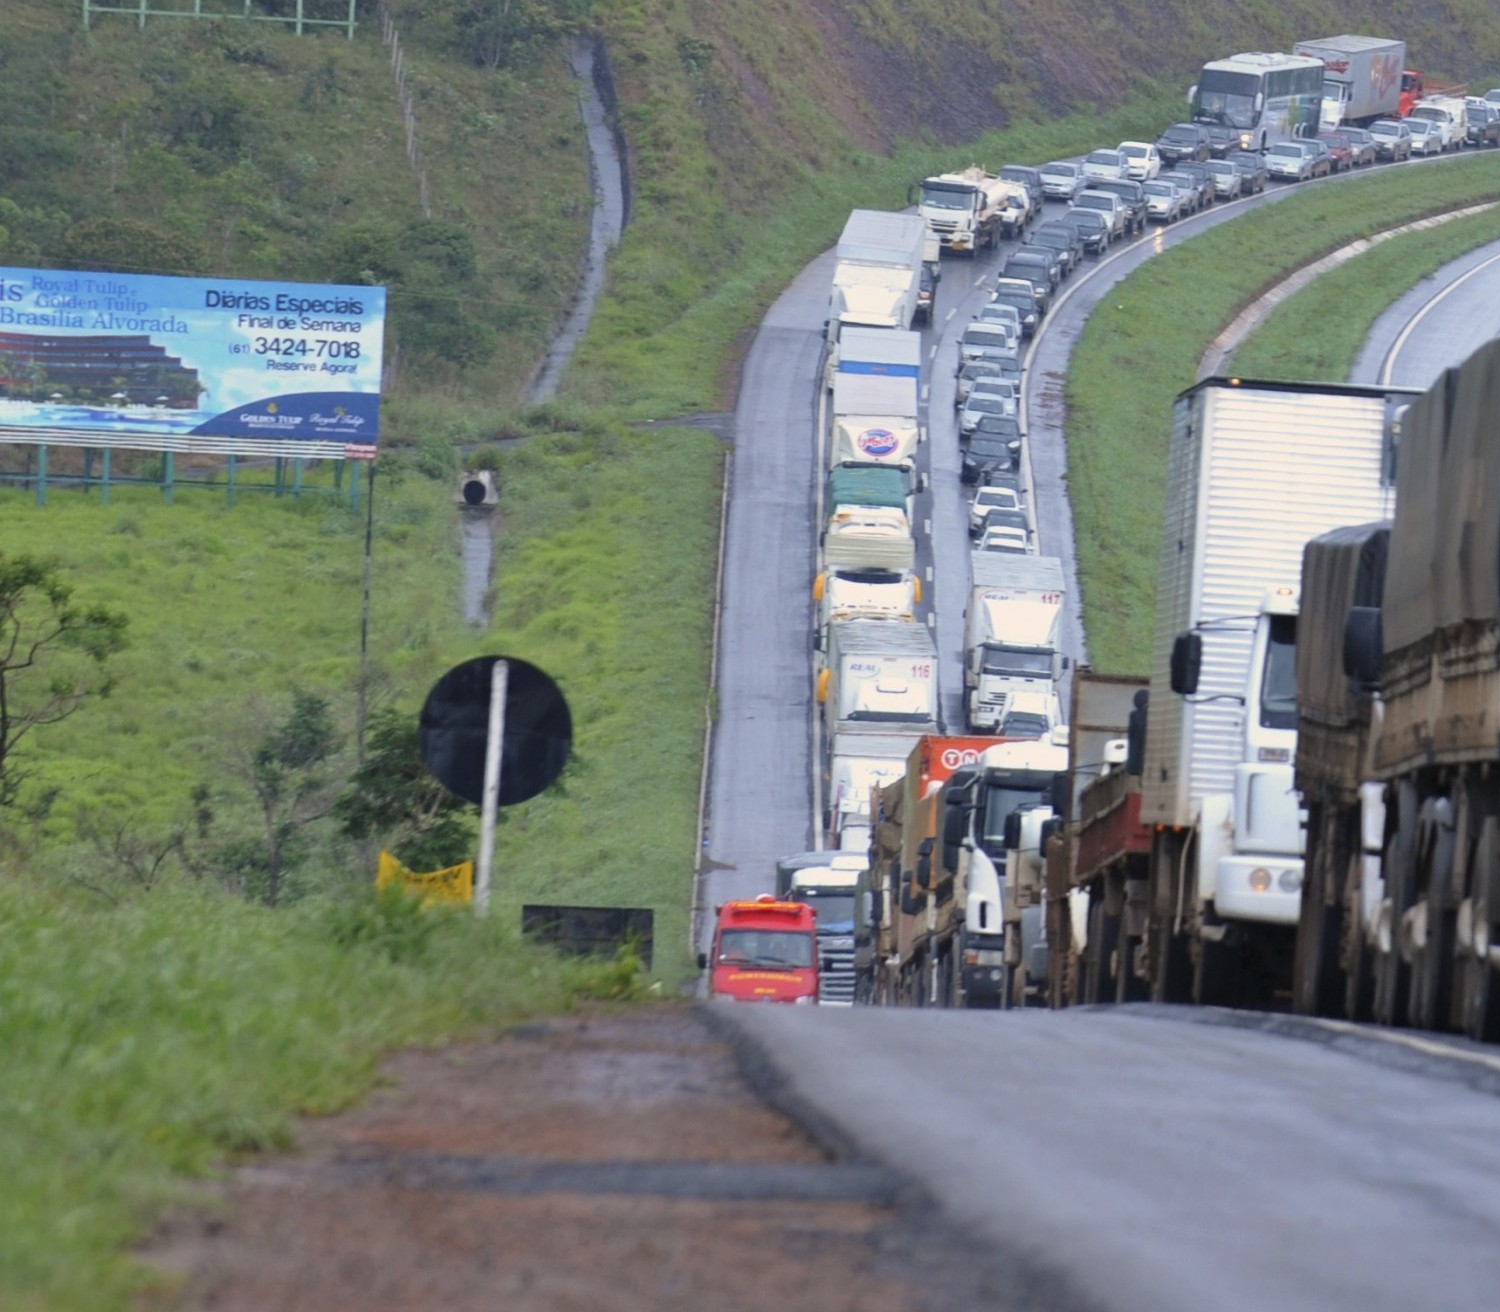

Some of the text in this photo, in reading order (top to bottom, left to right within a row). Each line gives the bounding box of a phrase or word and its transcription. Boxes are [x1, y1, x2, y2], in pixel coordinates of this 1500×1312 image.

[31, 276, 78, 293] Royal
[83, 279, 128, 296] Tulip
[35, 294, 149, 315] Golden Tulip
[276, 294, 364, 317] Especiais
[92, 313, 189, 334] Alvorada
[238, 315, 361, 333] Final de Semana
[255, 337, 361, 358] 3424-7018
[266, 360, 317, 371] Reserve
[1041, 593, 1061, 604] 117
